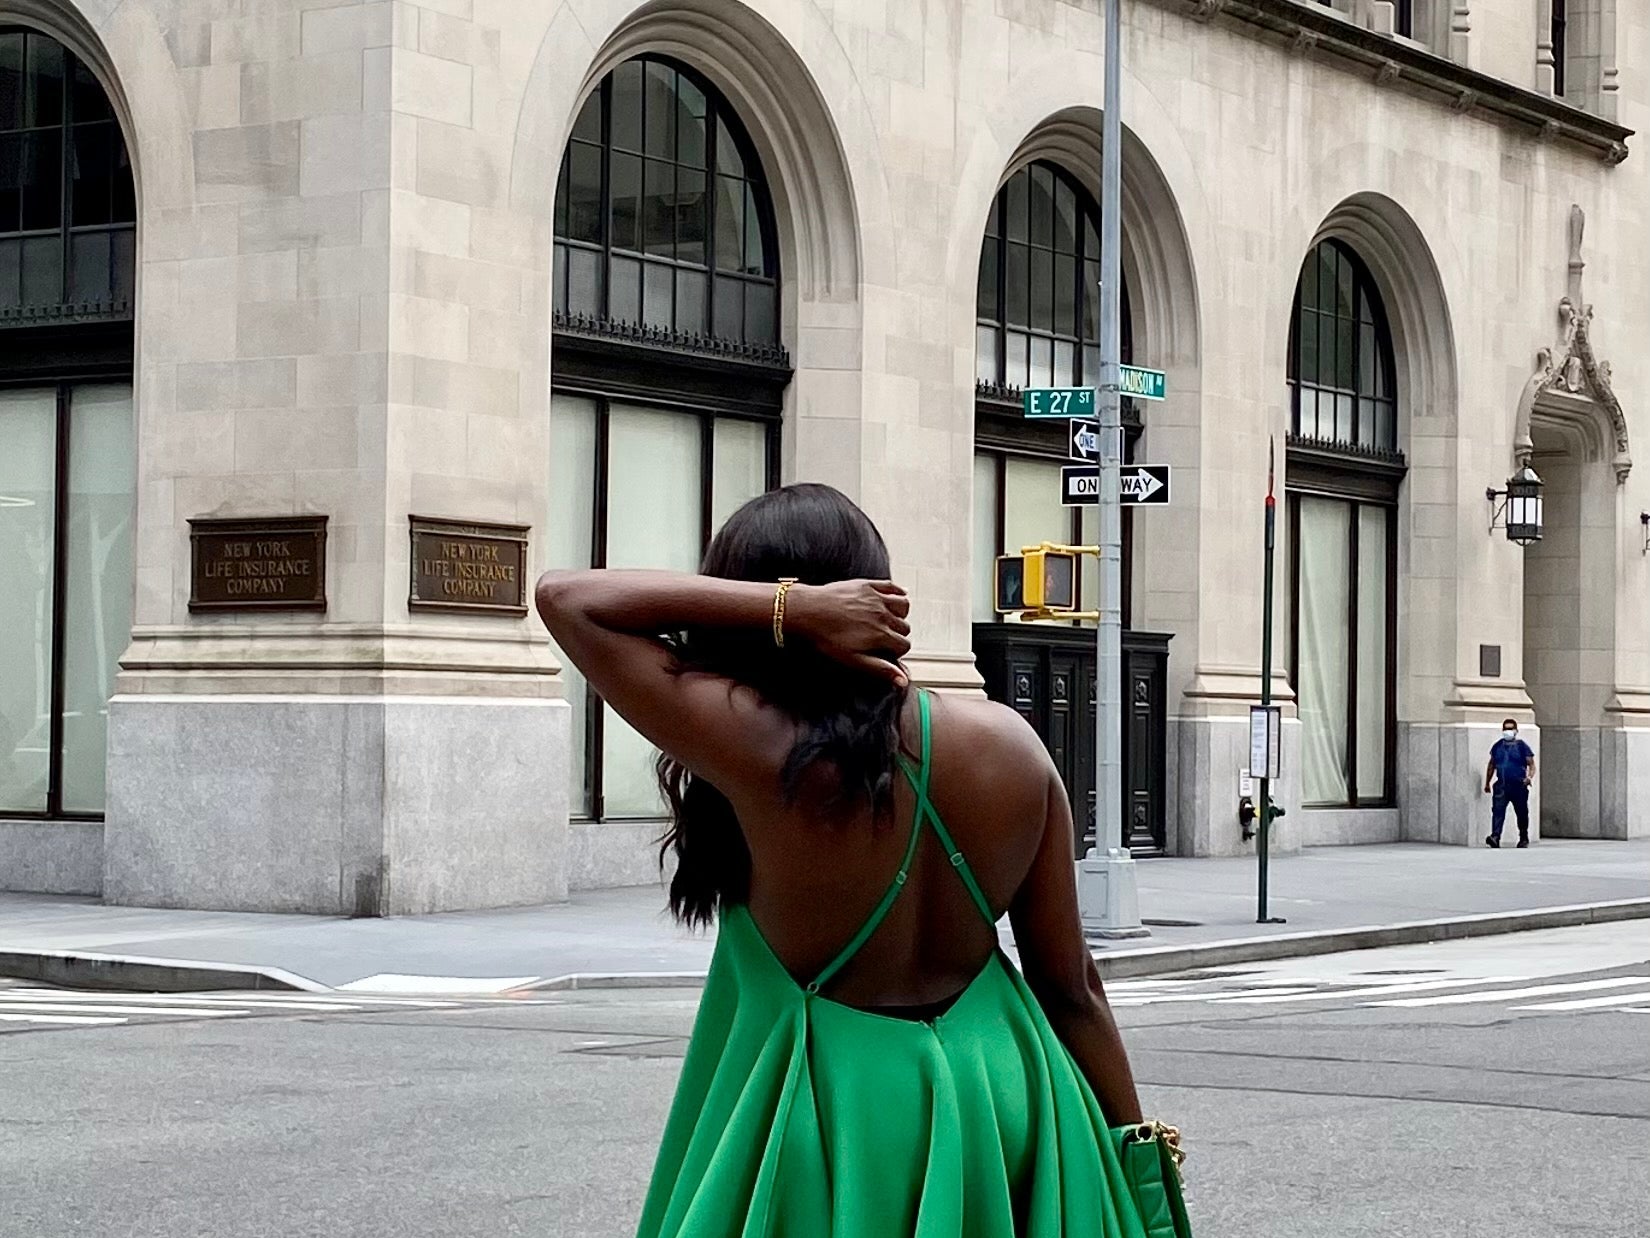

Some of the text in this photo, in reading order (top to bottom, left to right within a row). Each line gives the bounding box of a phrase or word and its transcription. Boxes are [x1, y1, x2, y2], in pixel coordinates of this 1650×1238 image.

[1030, 392, 1090, 413] E 27 ST
[1077, 478, 1153, 493] ON WAY
[224, 541, 290, 557] NEW YORK
[441, 542, 499, 562] NEW YORK
[205, 560, 311, 577] LIFE INSURANCE
[423, 559, 516, 582] LIFE INSURANCE
[226, 578, 286, 594] COMPANY
[443, 579, 497, 598] COMPANY
